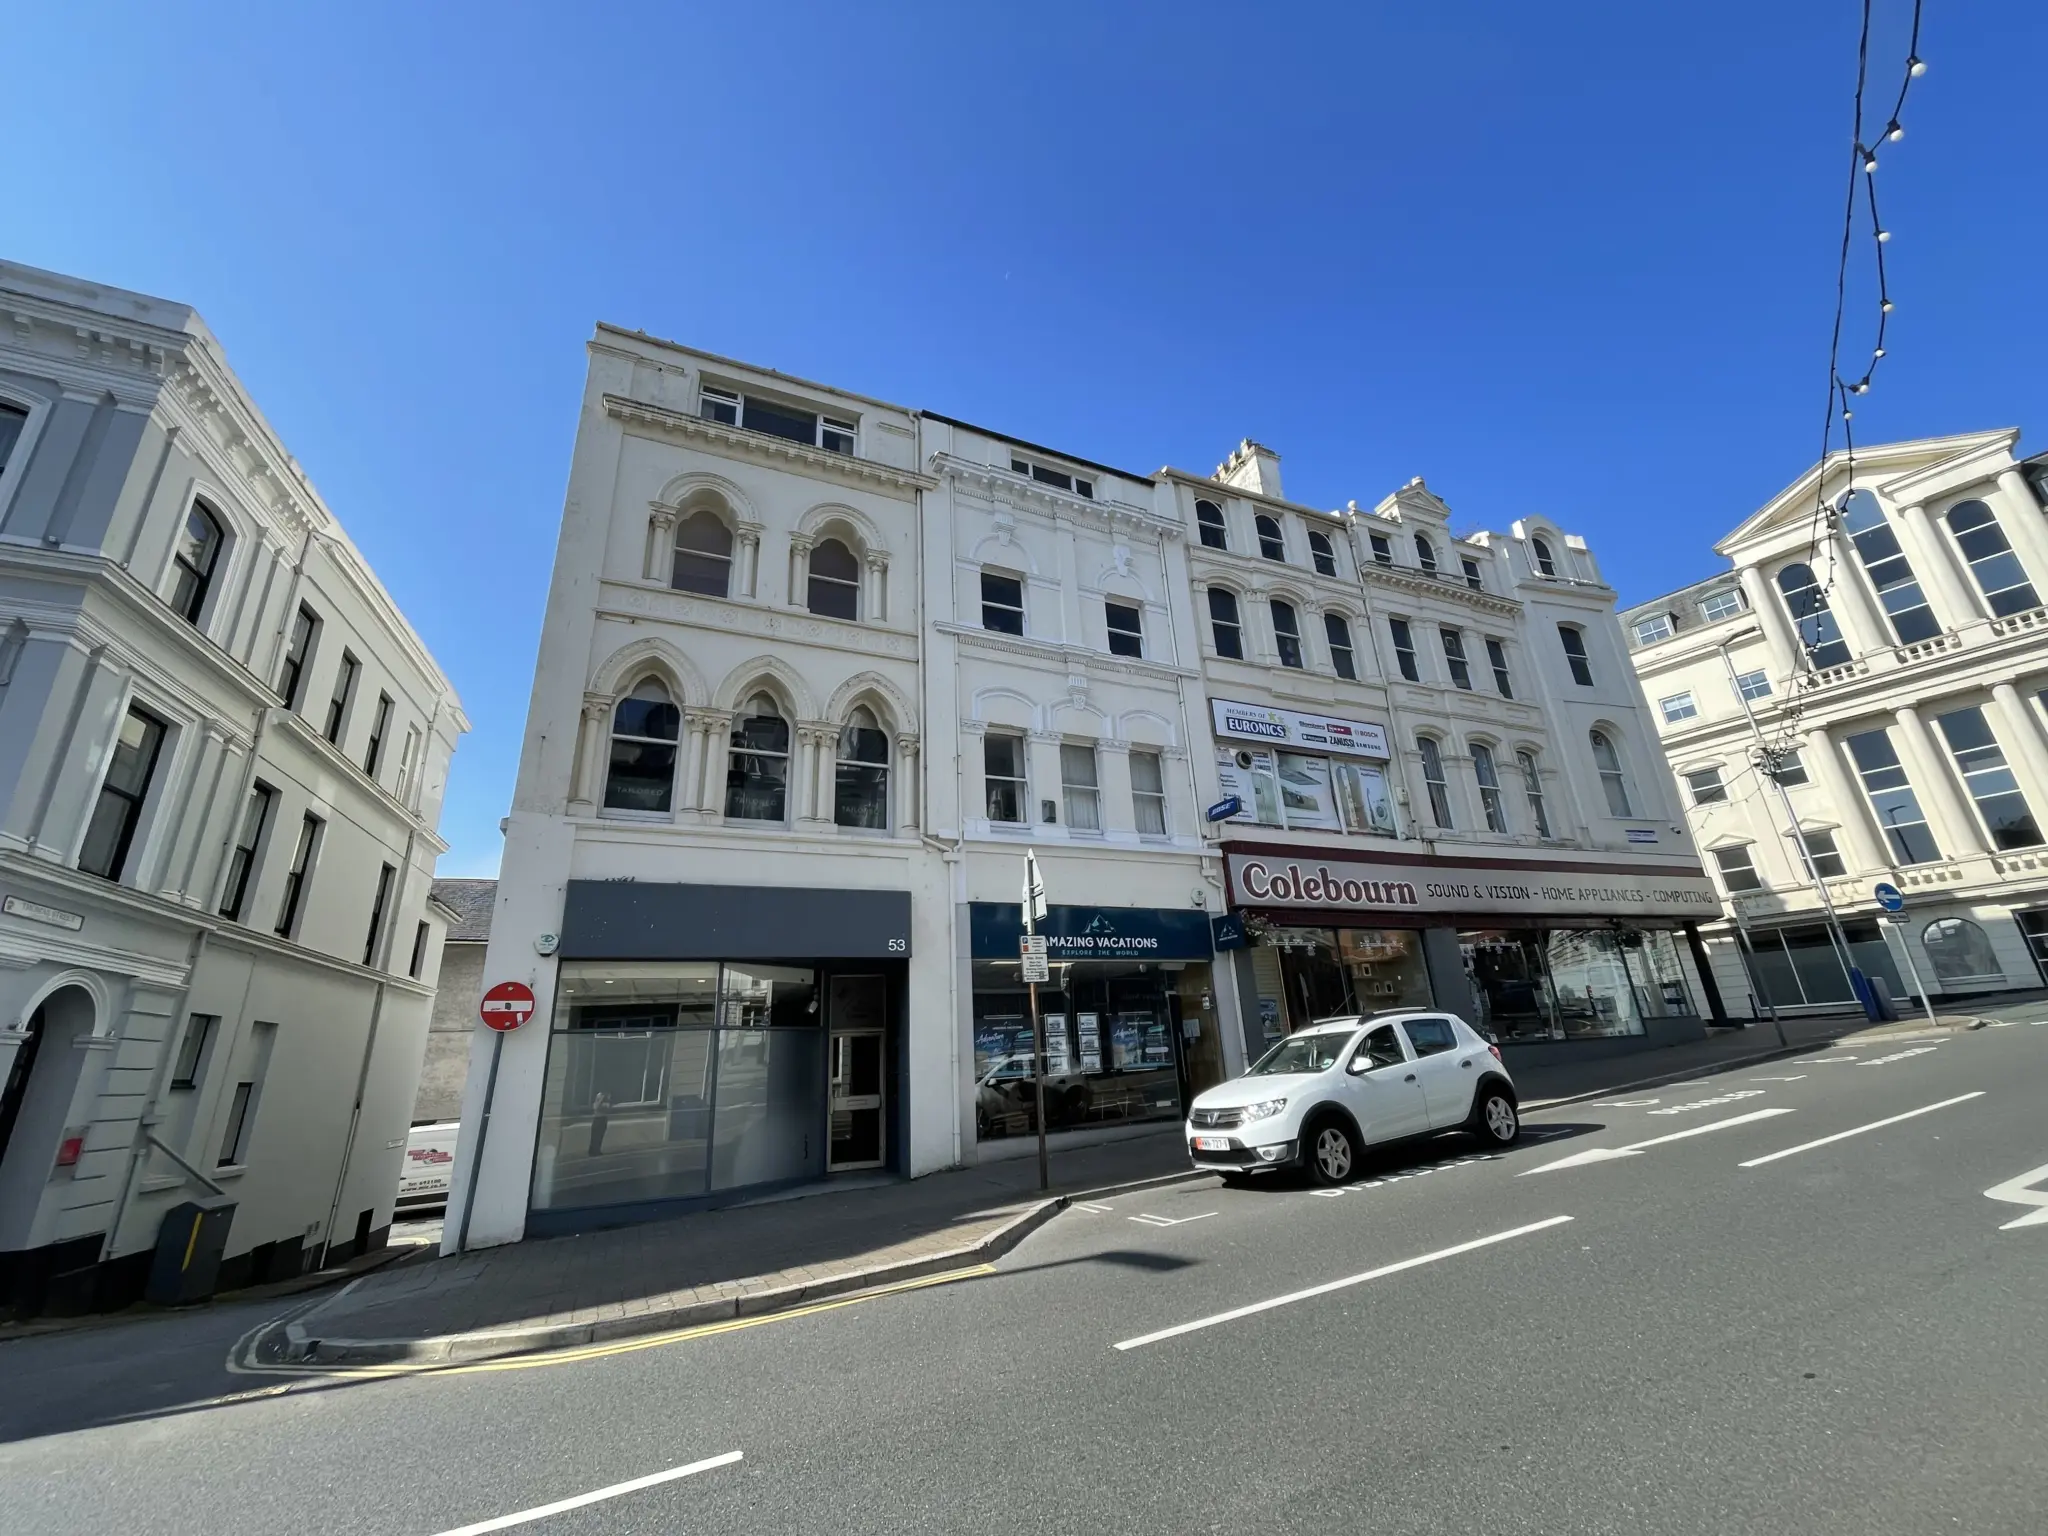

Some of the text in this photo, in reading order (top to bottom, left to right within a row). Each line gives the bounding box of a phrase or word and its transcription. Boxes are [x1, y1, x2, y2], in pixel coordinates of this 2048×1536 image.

[1226, 708, 1257, 718] MEMBERS
[1228, 718, 1284, 737] EURONICS
[1360, 730, 1379, 738] BOSCH
[1329, 736, 1356, 748] ZANUSSI
[1356, 742, 1382, 750] SAMSUNG
[1210, 801, 1233, 817] BOSE
[1241, 862, 1419, 906] Colebourn
[1426, 883, 1469, 899] SOUND
[1473, 885, 1483, 899] &
[1486, 885, 1530, 900] VISION
[1541, 886, 1575, 901] HOME
[1579, 887, 1644, 902] APPLIANCES
[1653, 890, 1713, 904] COMPUTING
[888, 938, 906, 951] 53
[1096, 937, 1158, 948] VACATIONS
